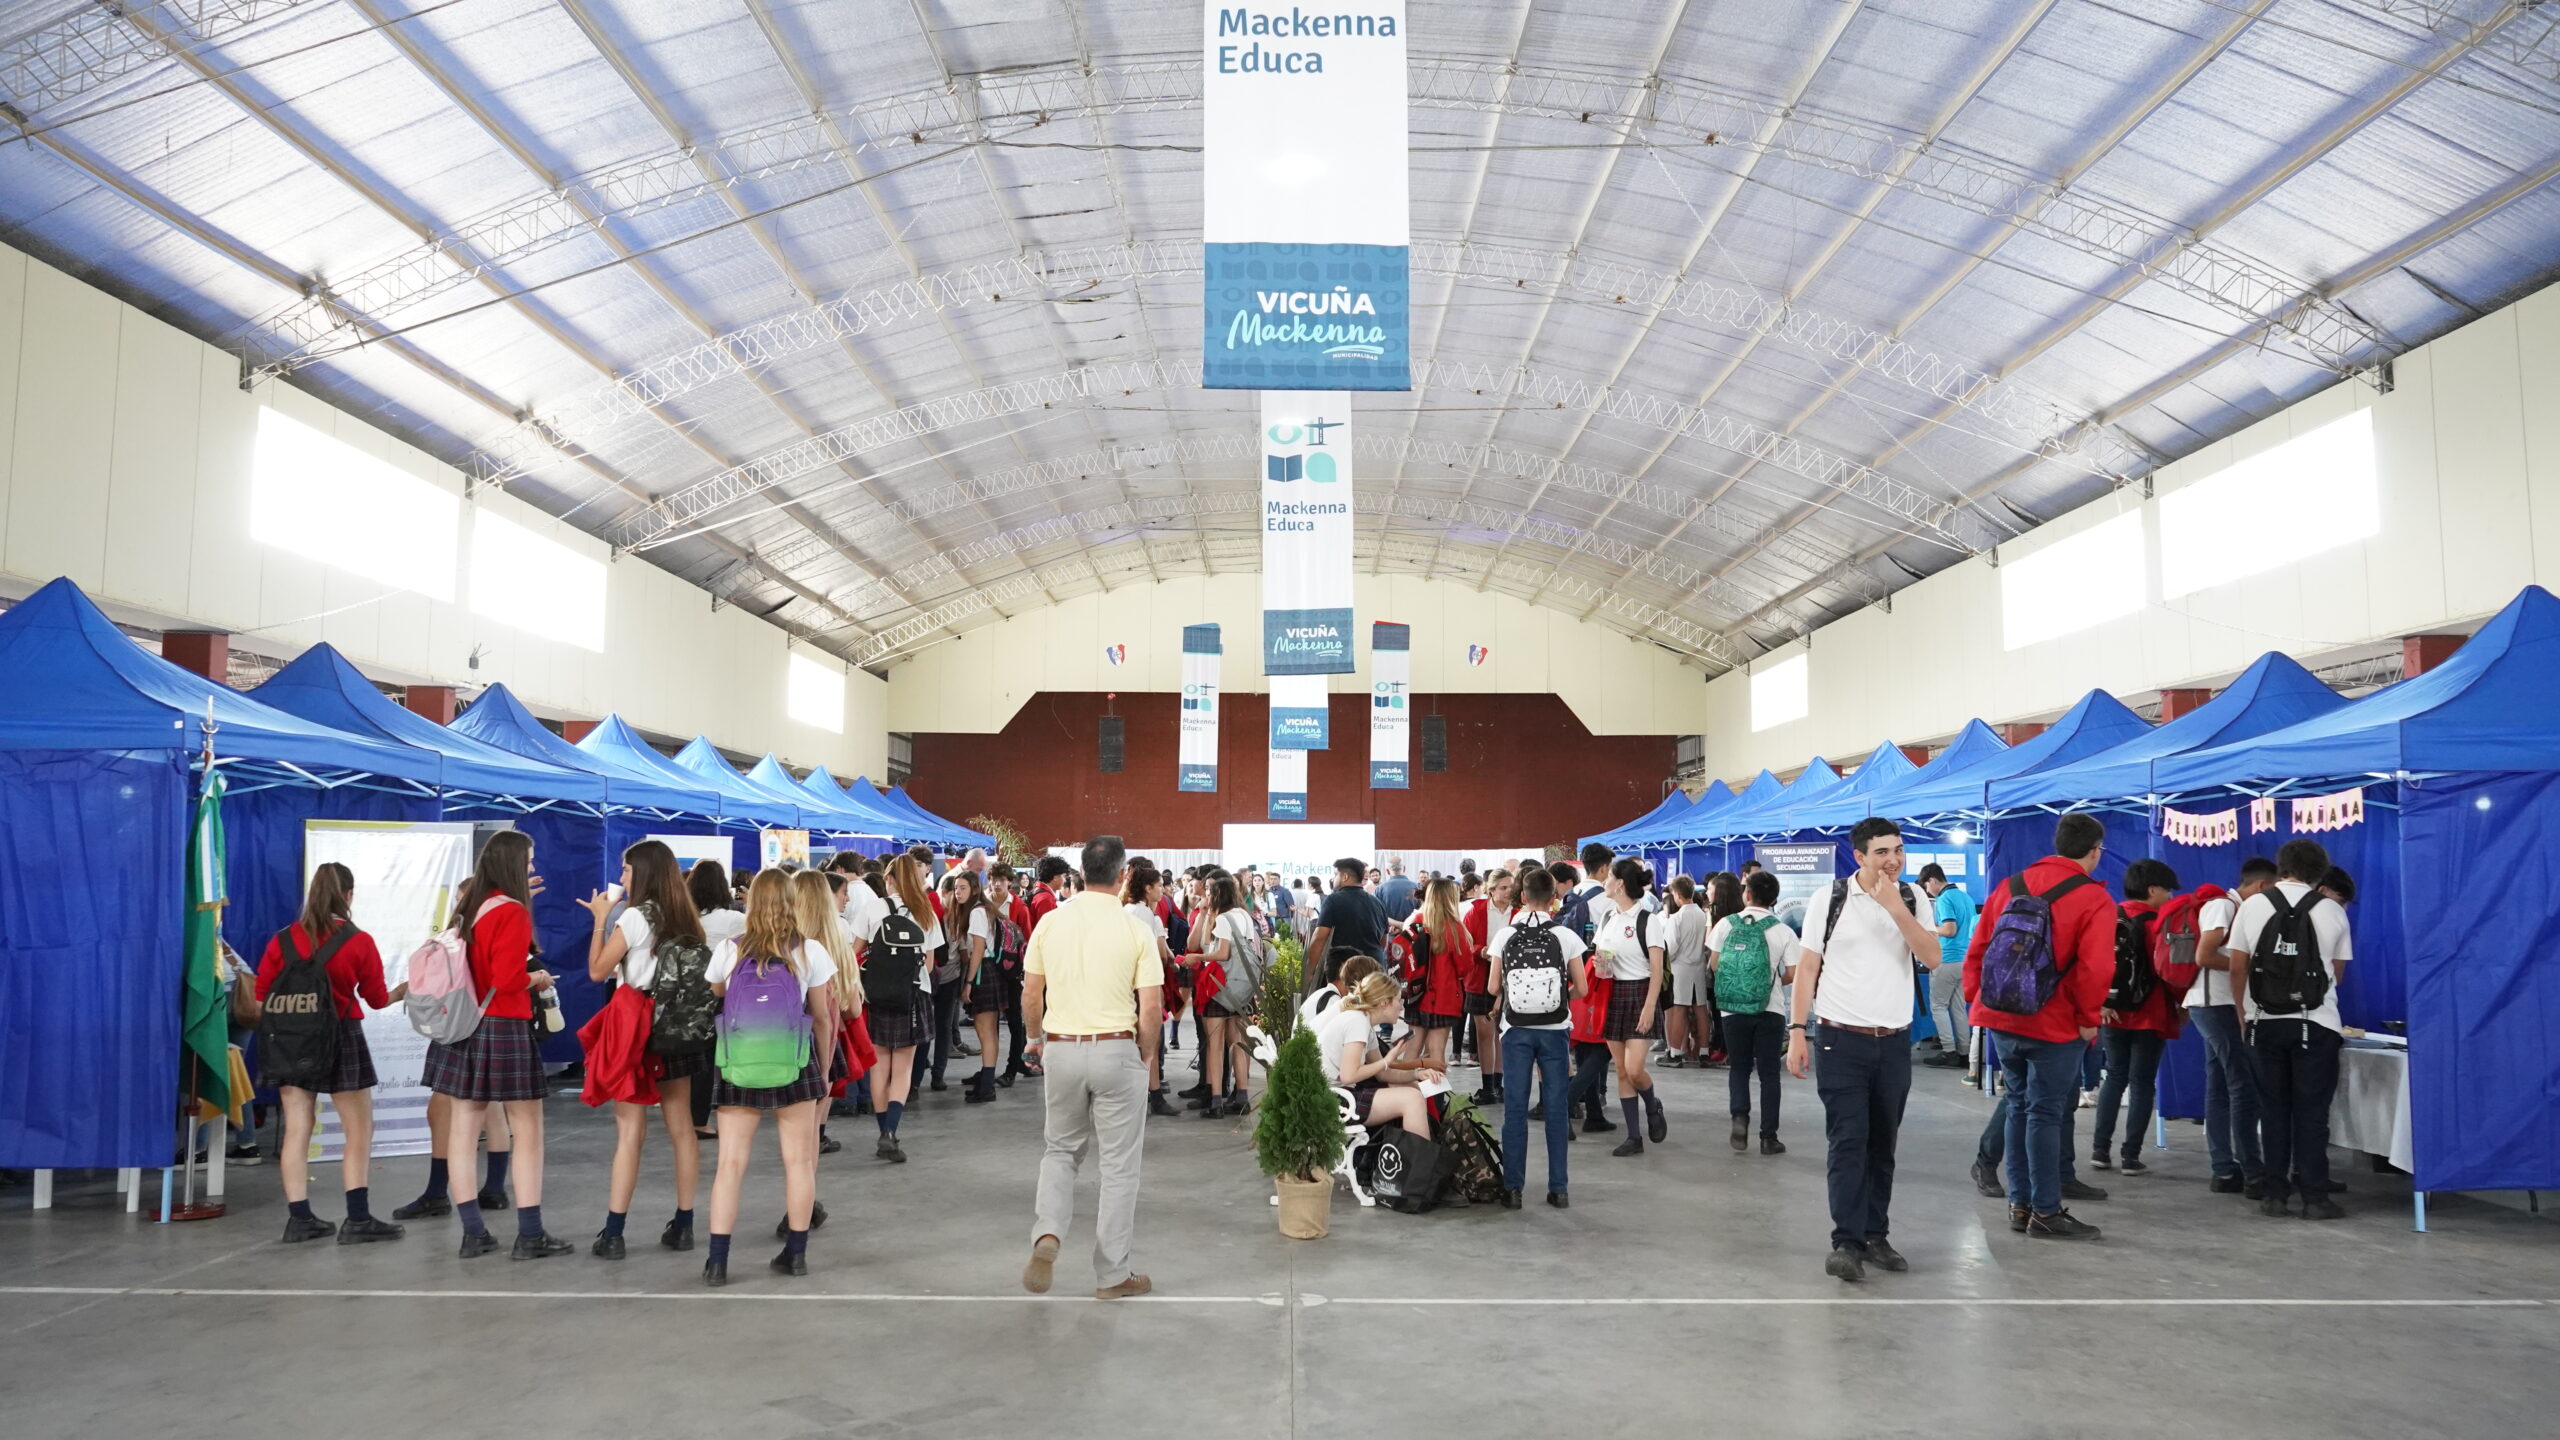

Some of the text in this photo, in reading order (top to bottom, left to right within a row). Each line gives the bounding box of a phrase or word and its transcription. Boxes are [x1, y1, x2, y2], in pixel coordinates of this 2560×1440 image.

[1218, 7, 1397, 37] Mackenna
[1218, 42, 1323, 74] Educa
[1256, 285, 1376, 315] VICUÑA
[1226, 309, 1386, 350] Mackenna
[1332, 352, 1379, 361] MUNICIPALIDAD
[1267, 500, 1347, 515] Mackenna
[1267, 518, 1314, 531] Educa
[1286, 624, 1338, 638] VICUÑA
[1273, 636, 1343, 655] Mackenna
[1183, 717, 1216, 725] Mackenna
[1285, 717, 1319, 726] VICUÑA
[1276, 724, 1322, 736] Mackenna
[2167, 801, 2360, 839] PENSANDO EN MAÑANA
[1783, 855, 1818, 863] EDUCACIÓN
[1282, 862, 1332, 875] Macken
[265, 992, 318, 1014] LOVER
